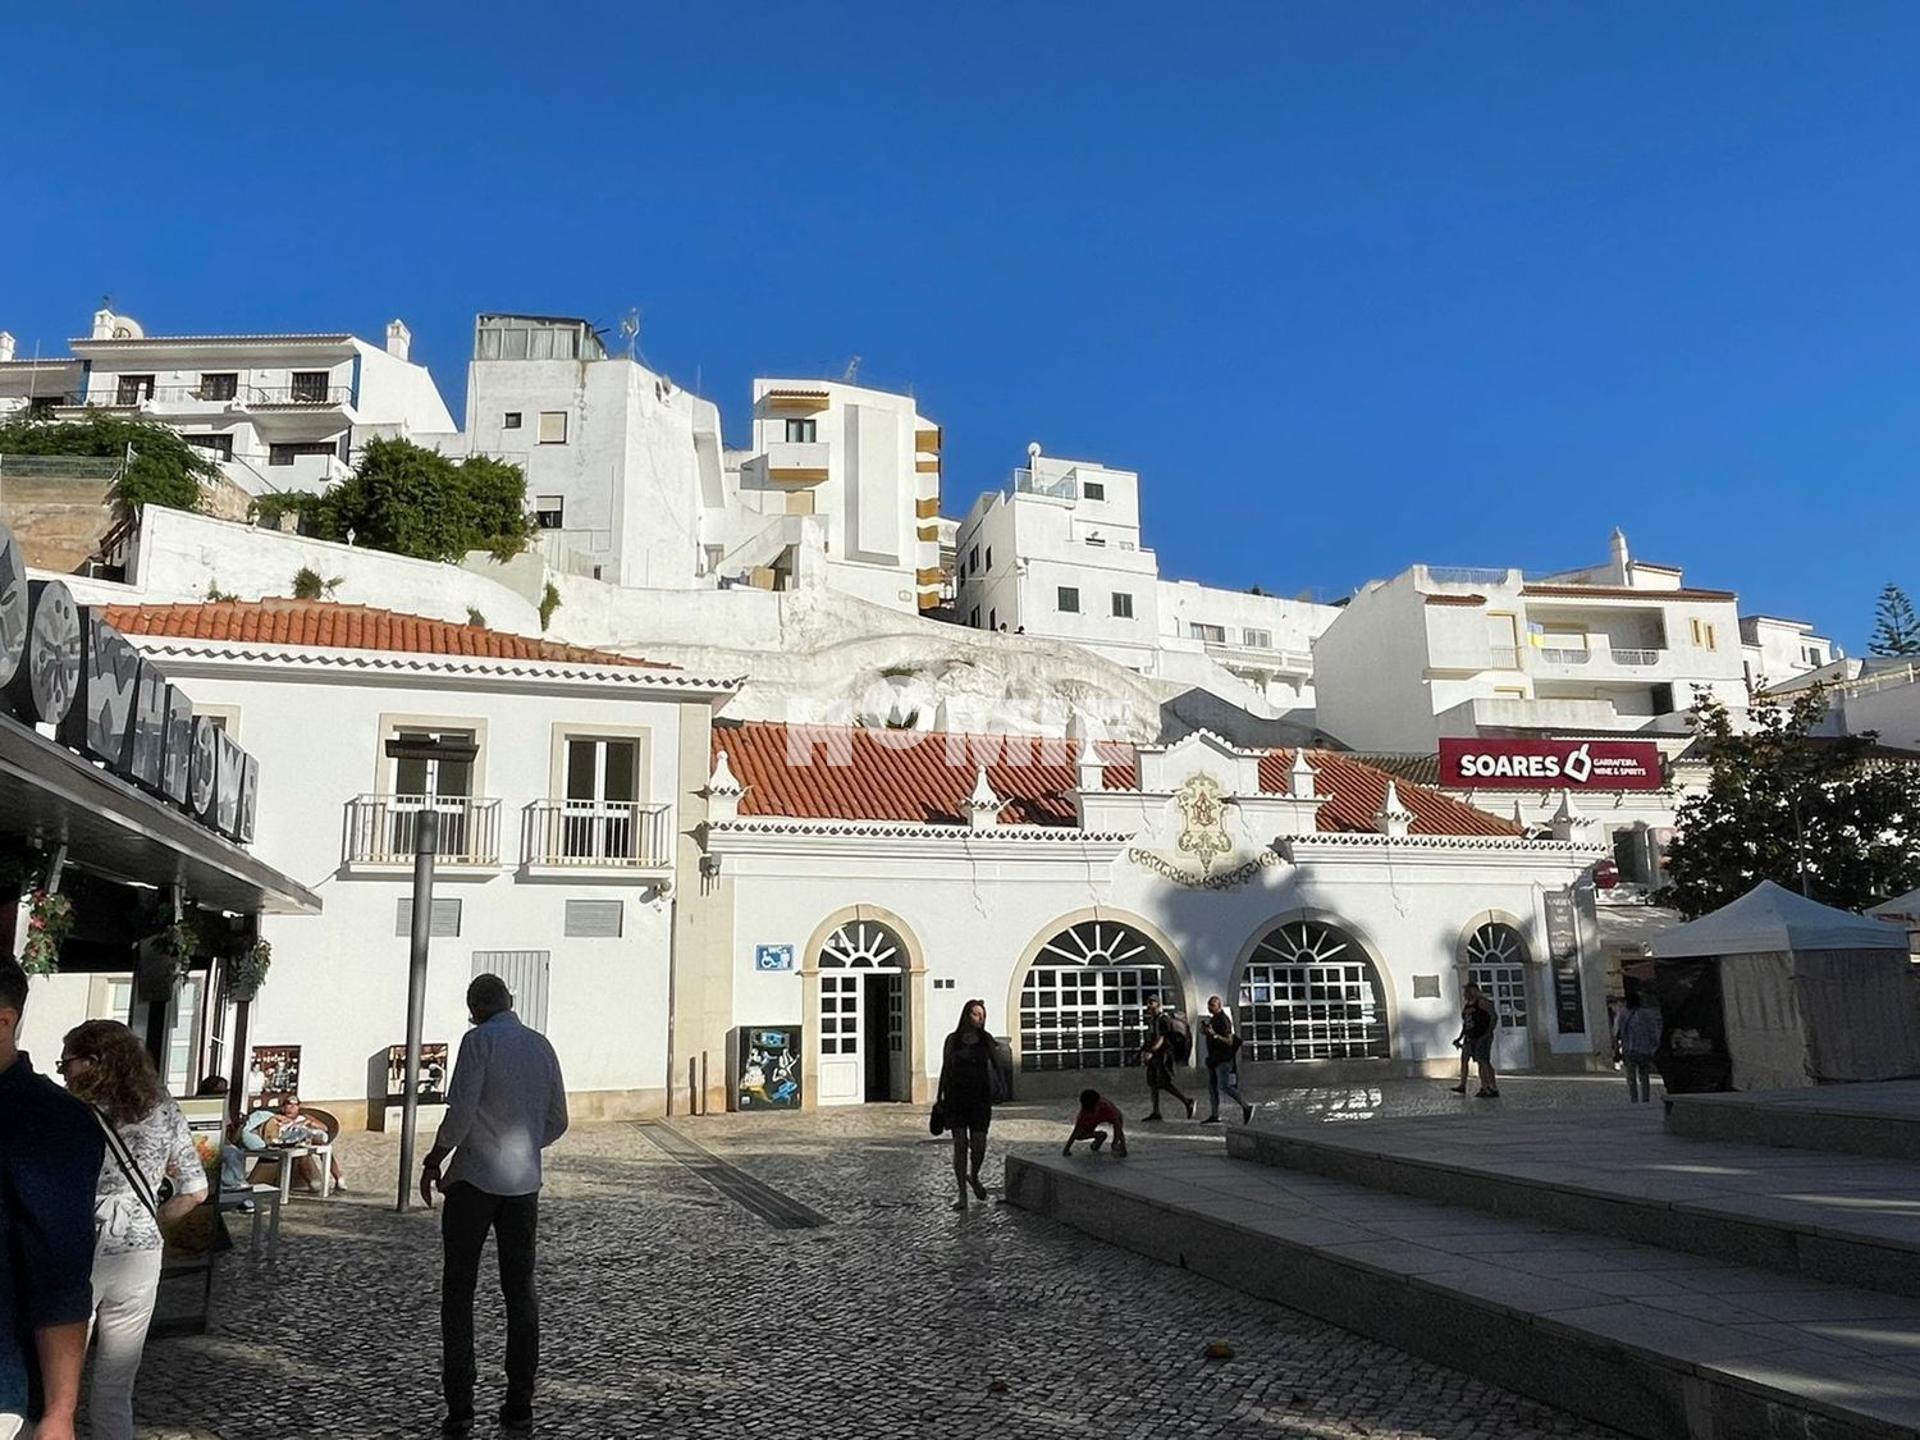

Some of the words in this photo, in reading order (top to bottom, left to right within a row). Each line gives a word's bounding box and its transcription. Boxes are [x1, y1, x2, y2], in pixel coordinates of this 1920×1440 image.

[1460, 754, 1561, 777] SOARES
[1593, 767, 1613, 776] WINE
[1620, 767, 1647, 776] SPIRITS
